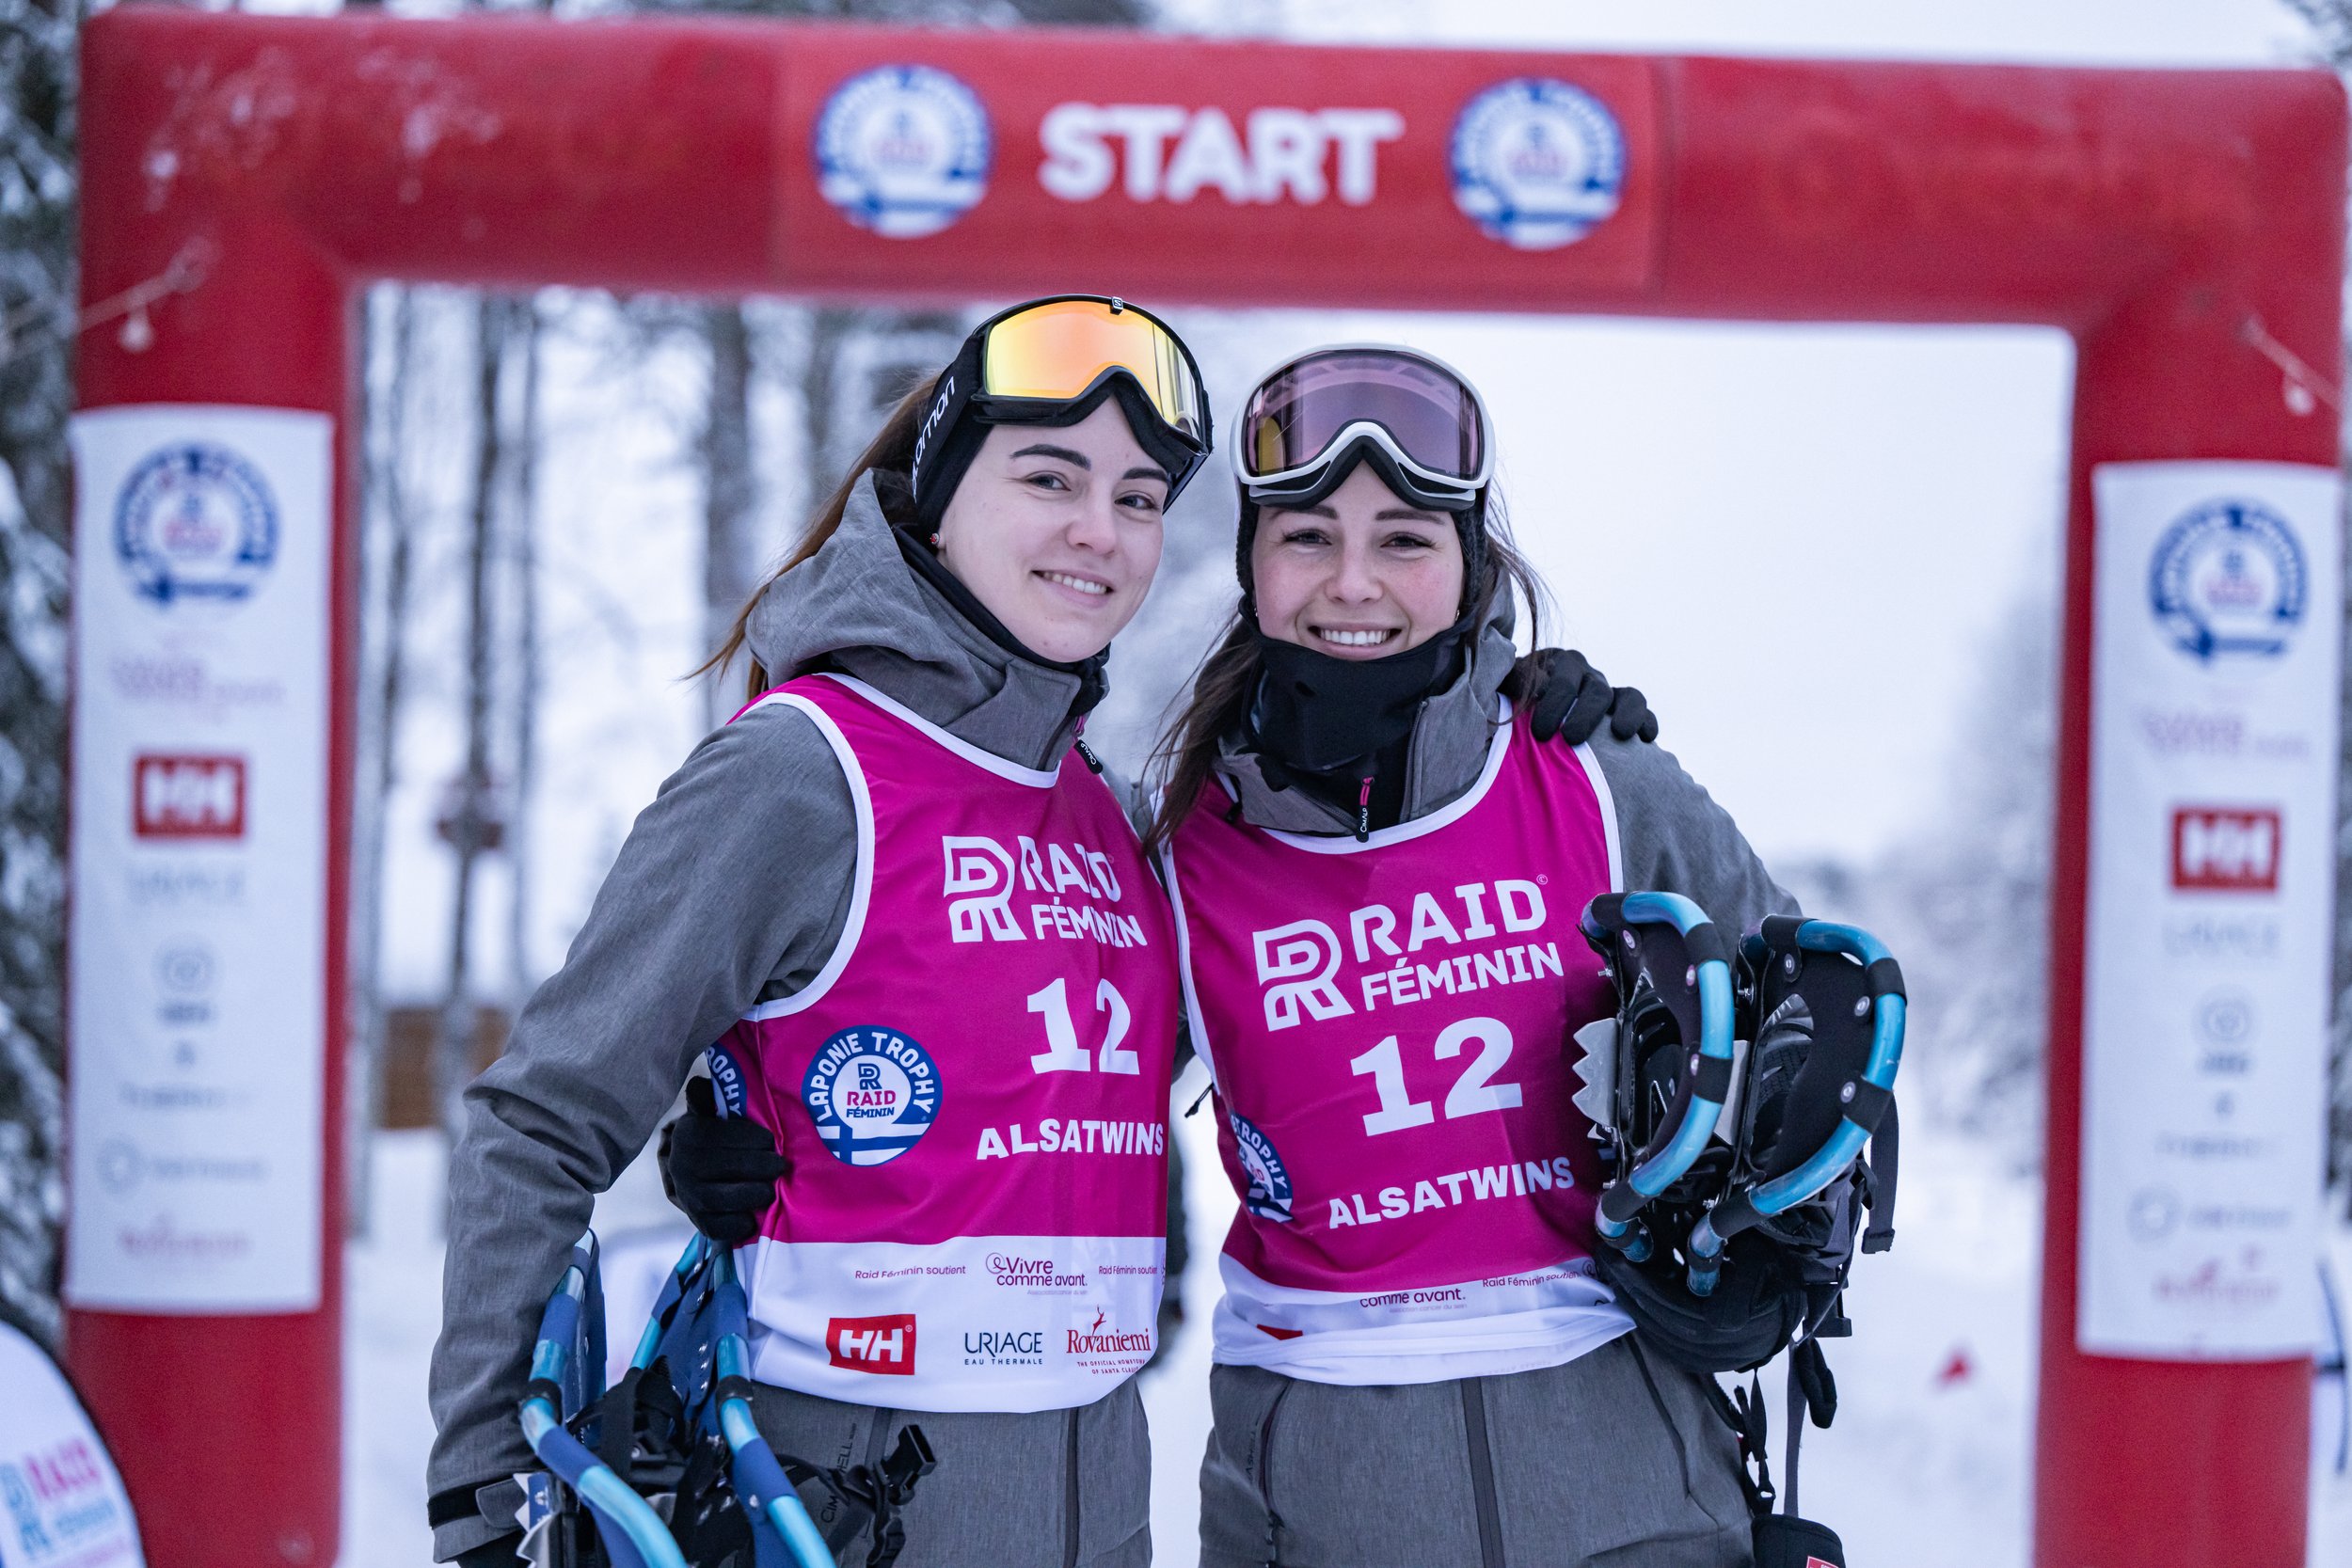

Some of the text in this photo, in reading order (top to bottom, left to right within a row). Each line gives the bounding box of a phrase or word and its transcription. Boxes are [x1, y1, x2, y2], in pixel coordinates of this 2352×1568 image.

[1041, 102, 1406, 207] START
[1017, 835, 1122, 903] RAID
[1031, 895, 1148, 948] FÉMININ
[1349, 879, 1548, 963] RAID
[1360, 942, 1565, 1011] FÉMININ
[1026, 977, 1140, 1075] 12
[706, 1046, 742, 1117] ROPHY
[809, 1032, 935, 1122] LAPONIE TROPHY
[1350, 1016, 1523, 1137] 12
[846, 1106, 895, 1118] FÉMININ
[847, 1090, 897, 1106] RAID
[976, 1118, 1164, 1160] ALSATWINS
[1328, 1156, 1575, 1229] ALSATWINS
[855, 1270, 879, 1278] Raid
[926, 1265, 966, 1275] soutient
[996, 1274, 1052, 1286] comme
[1006, 1257, 1054, 1275] Vivre
[1099, 1265, 1112, 1275] Raid
[1482, 1276, 1505, 1288] Raid
[1508, 1275, 1544, 1287] Féminin
[1359, 1292, 1409, 1307] comme
[838, 1328, 903, 1363] HH
[964, 1332, 1043, 1357] URIAGE
[1066, 1328, 1151, 1354] Rovaniemi
